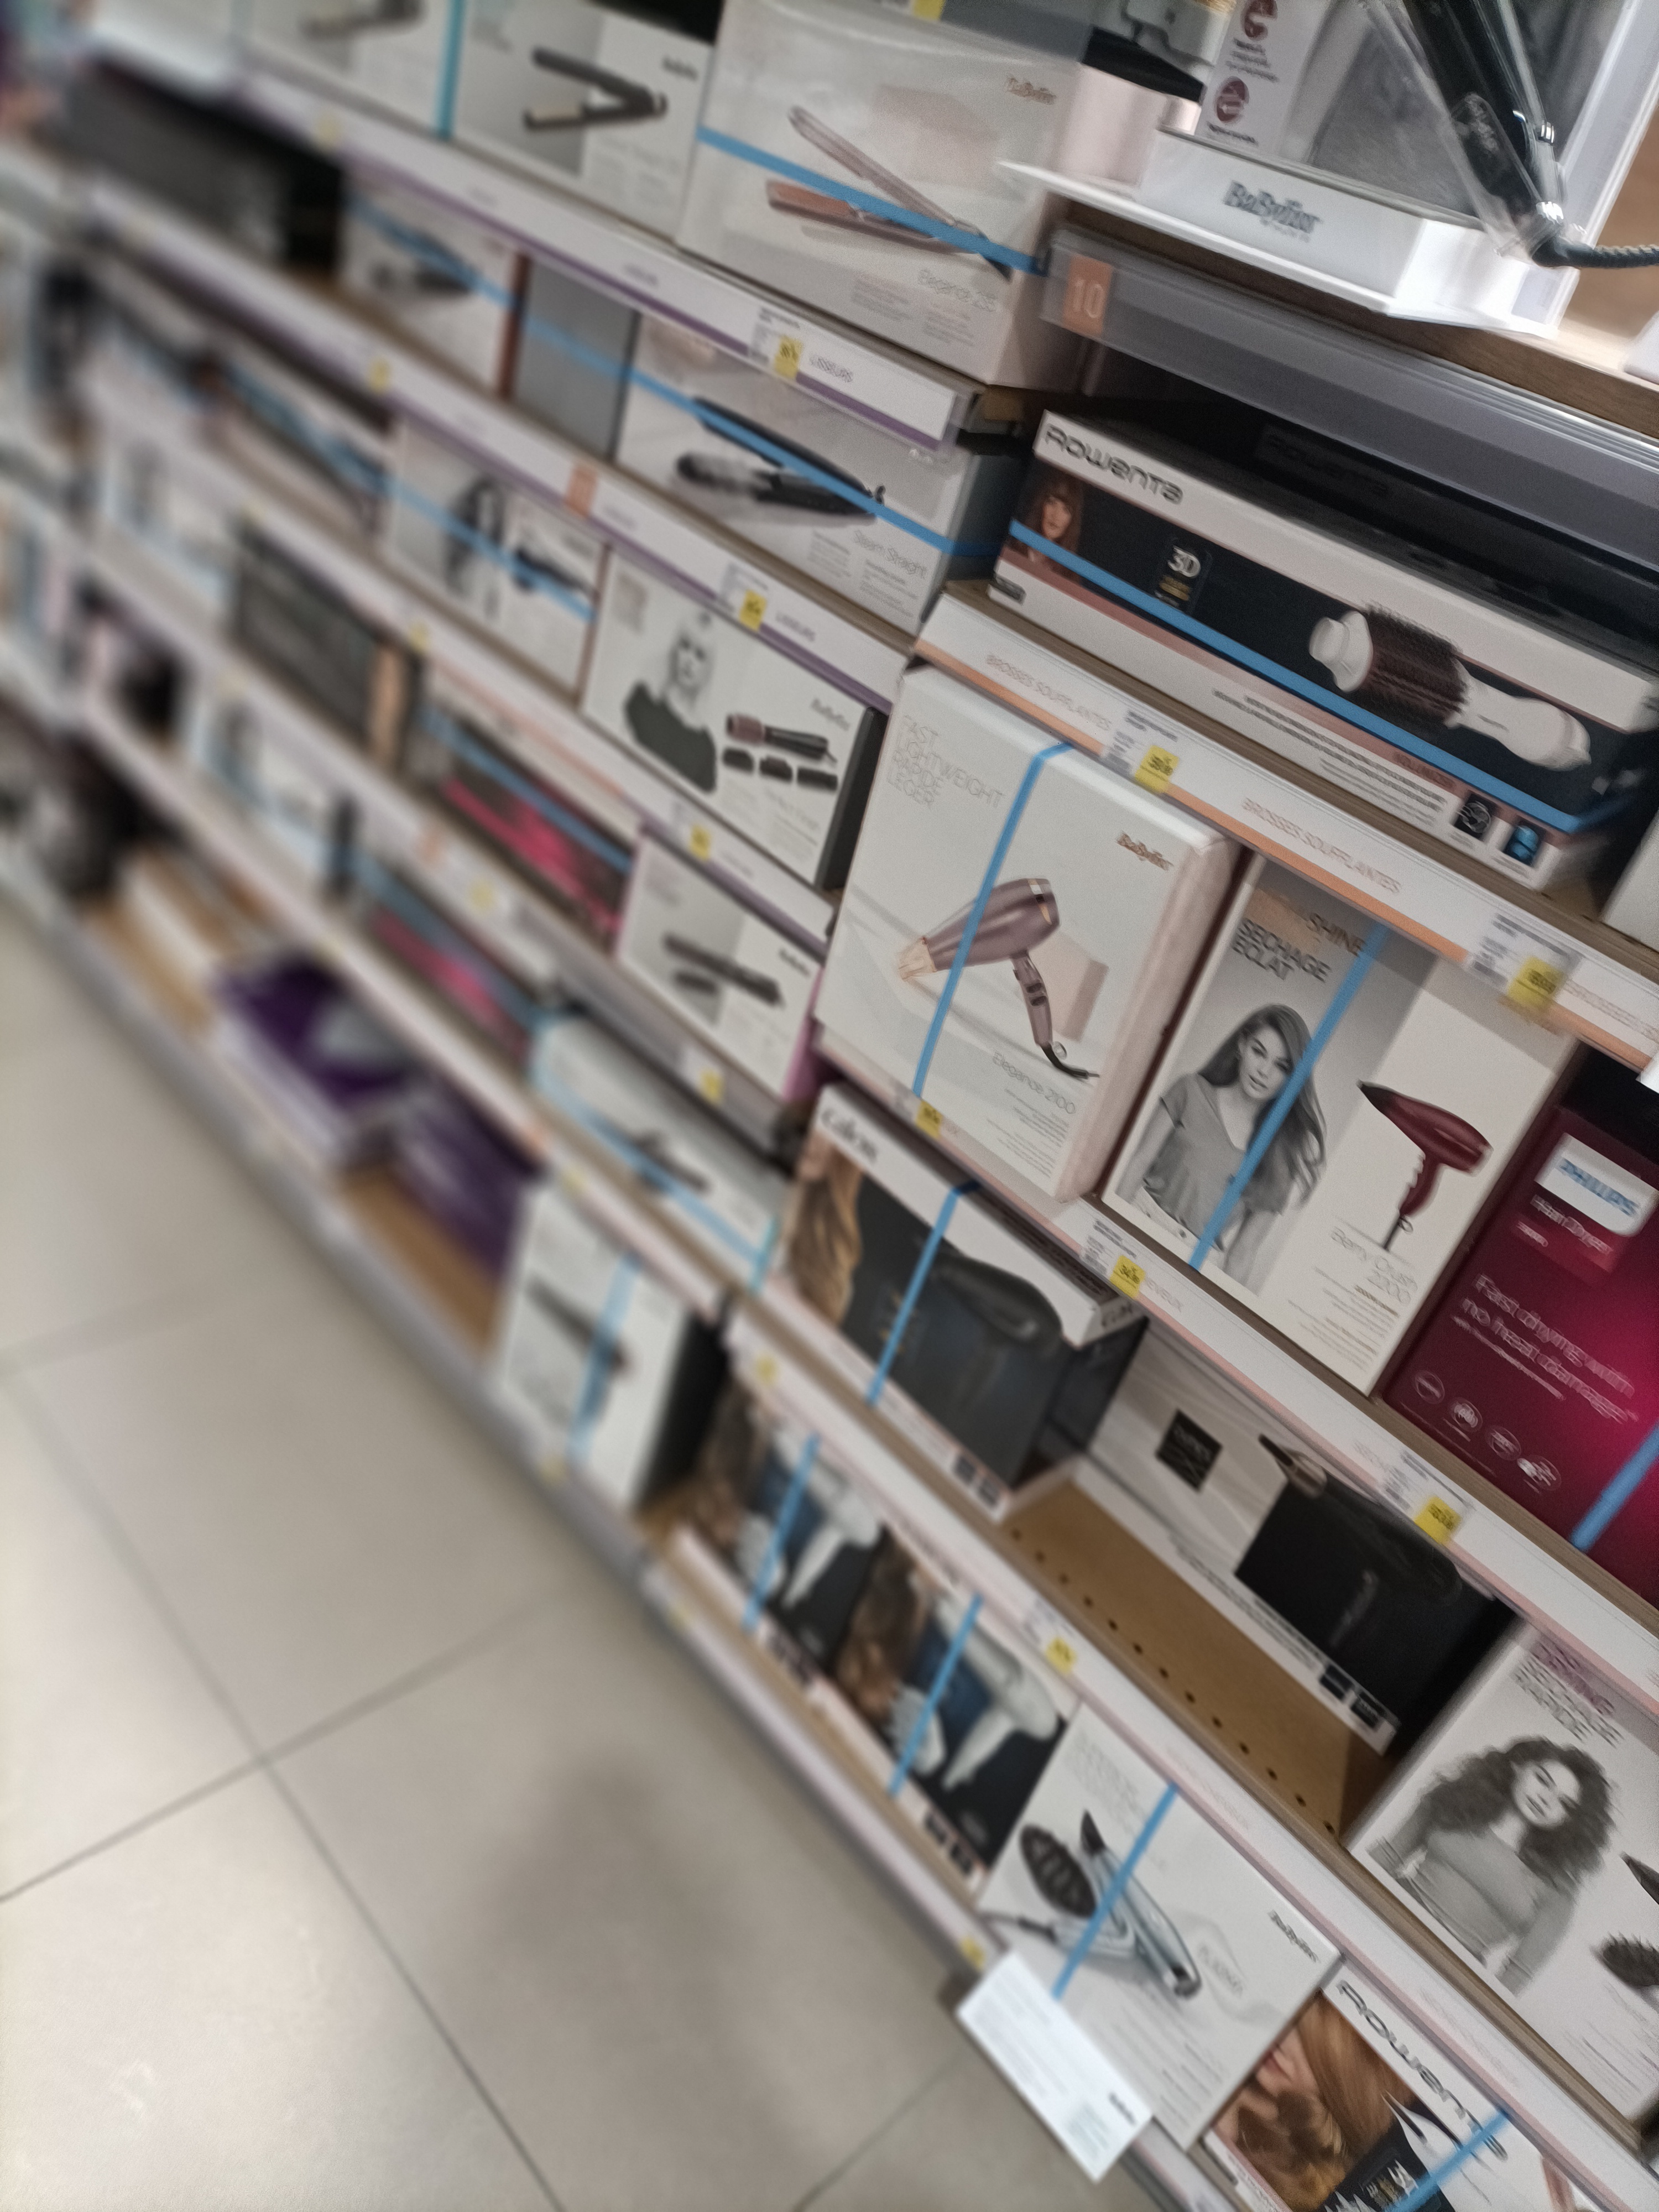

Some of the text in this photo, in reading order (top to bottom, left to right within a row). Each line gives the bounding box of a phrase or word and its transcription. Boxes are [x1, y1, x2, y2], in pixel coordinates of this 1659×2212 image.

[1223, 181, 1321, 235] BaByliss
[1071, 276, 1102, 320] 10
[1168, 545, 1201, 579] 3D
[993, 1050, 1077, 1117] Elegance 2100
